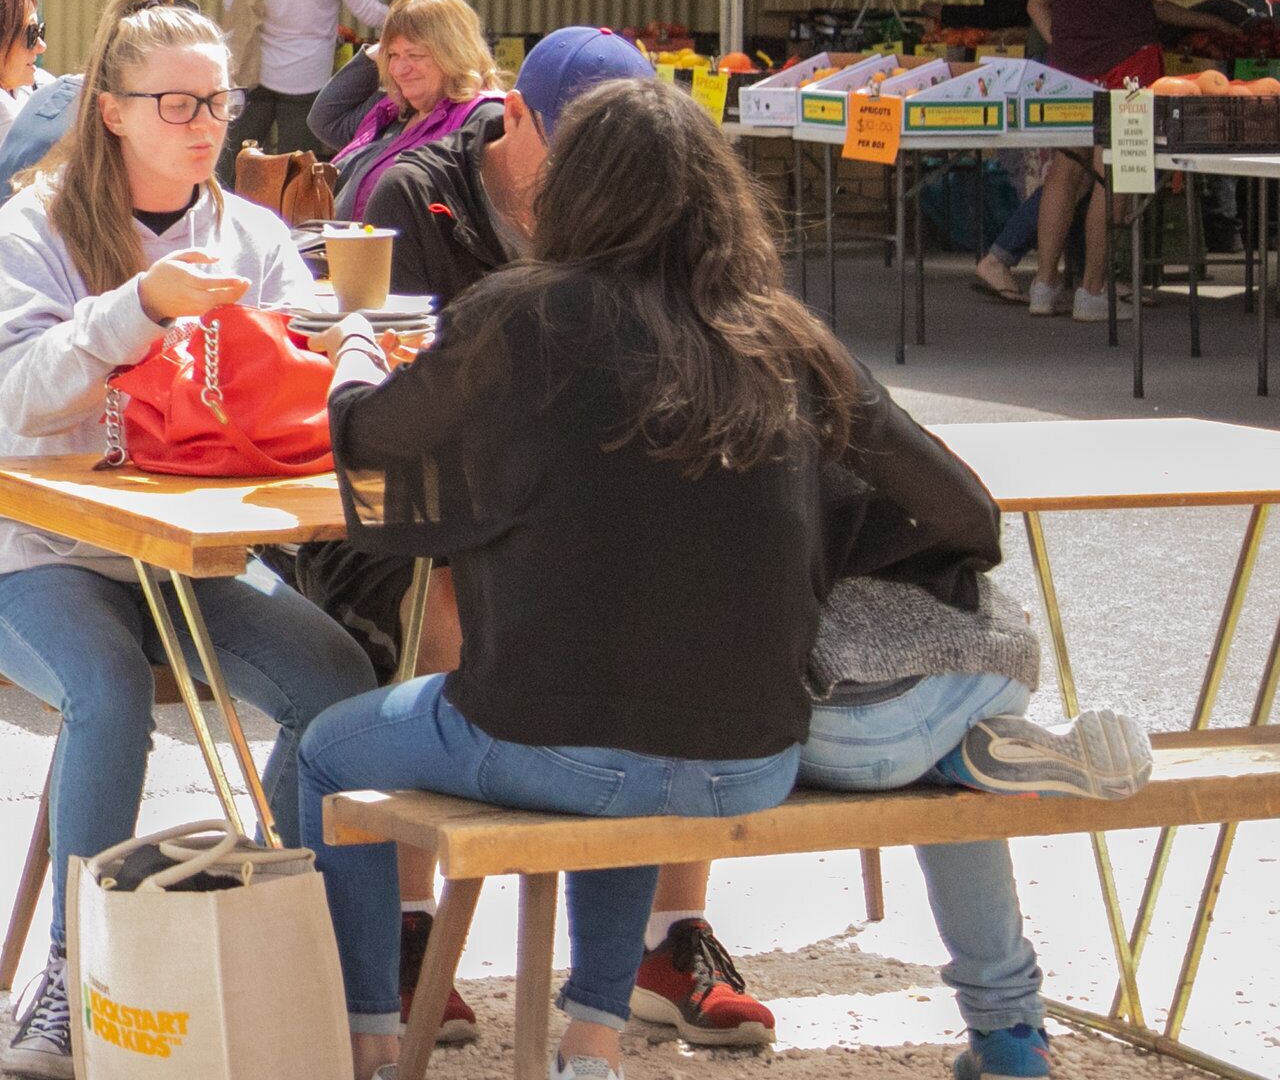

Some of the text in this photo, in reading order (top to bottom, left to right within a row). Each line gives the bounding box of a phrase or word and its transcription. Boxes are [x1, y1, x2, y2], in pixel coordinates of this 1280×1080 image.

[859, 105, 892, 117] APRICOTS
[1118, 103, 1149, 114] SPECIAL
[857, 139, 886, 149] PER BOX
